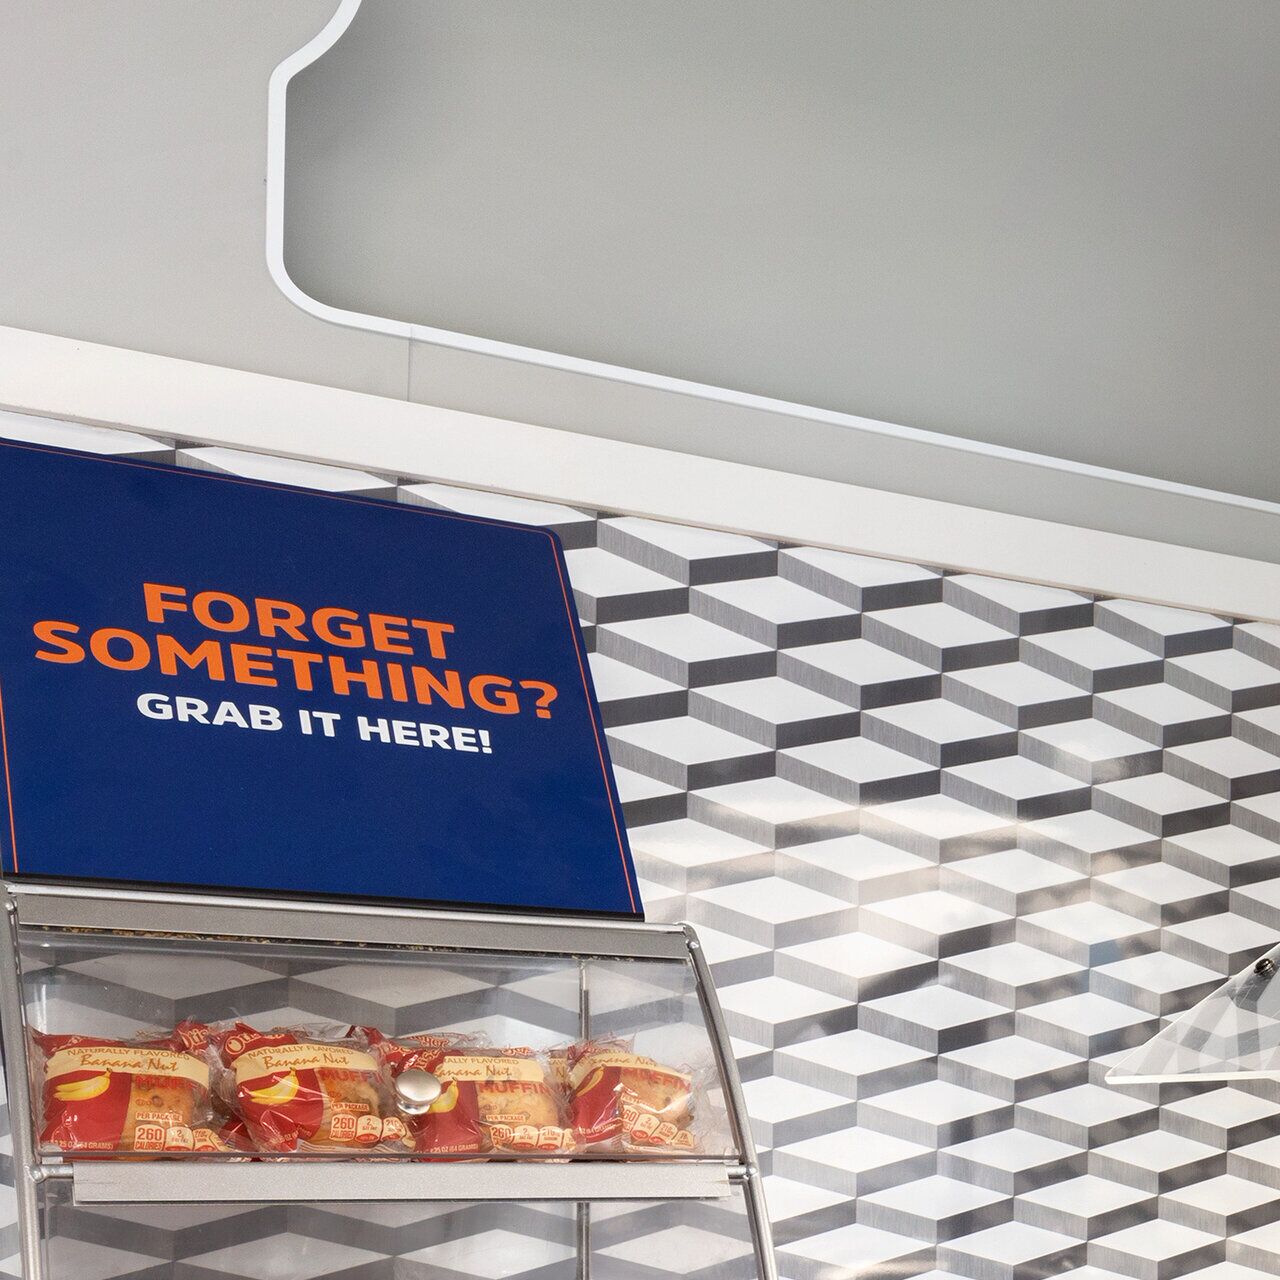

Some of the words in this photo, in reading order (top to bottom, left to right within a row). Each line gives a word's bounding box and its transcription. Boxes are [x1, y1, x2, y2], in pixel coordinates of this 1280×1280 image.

[142, 581, 456, 660] FORGET
[32, 619, 559, 720] SOMETHING?
[135, 692, 284, 732] GRAB
[298, 708, 342, 738] IT
[357, 714, 494, 755] HERE!
[66, 1047, 131, 1057] NATURALLY
[247, 1044, 304, 1061] NATURALLY
[470, 1056, 520, 1065] FLAVORED
[79, 1053, 144, 1069] Banana
[146, 1056, 179, 1072] Nut
[263, 1056, 321, 1070] Banana
[322, 1053, 351, 1066] Nut
[435, 1066, 483, 1078] anana
[485, 1065, 513, 1077] Nut
[332, 1116, 355, 1129] 260
[136, 1127, 164, 1141] 260
